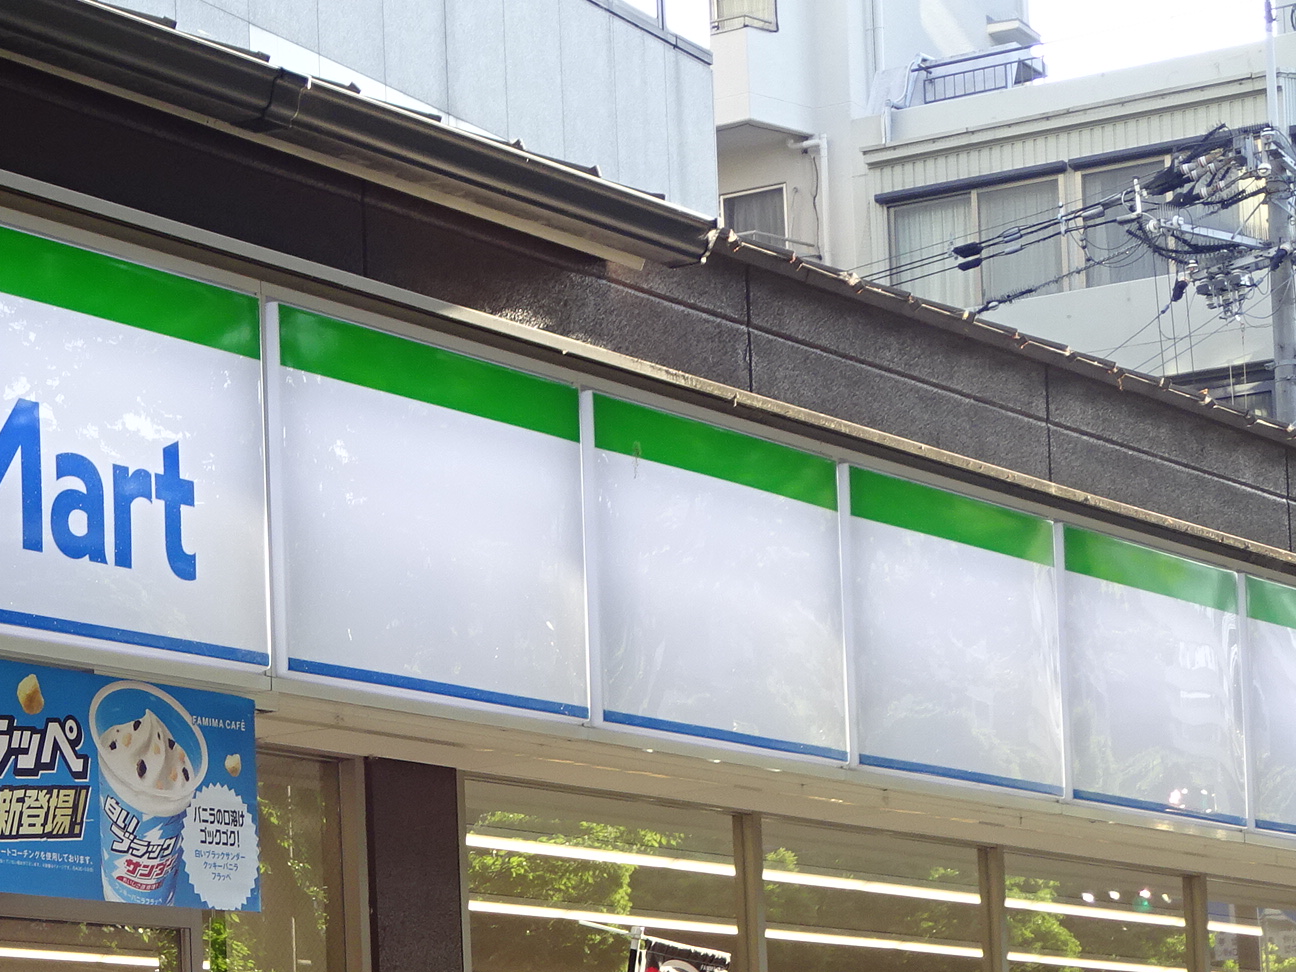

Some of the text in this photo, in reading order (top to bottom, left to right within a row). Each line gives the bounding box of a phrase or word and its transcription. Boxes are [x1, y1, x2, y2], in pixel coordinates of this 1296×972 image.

[191, 715, 246, 731] FAMIMA CAFÉ
[104, 795, 140, 834] 白い
[193, 806, 245, 828] バニラの口溶け
[110, 822, 179, 860] ブラック
[199, 827, 240, 848] ゴックゴク!
[194, 849, 247, 861] 白いブラックサンダー
[202, 861, 239, 872] クッキーバニラ
